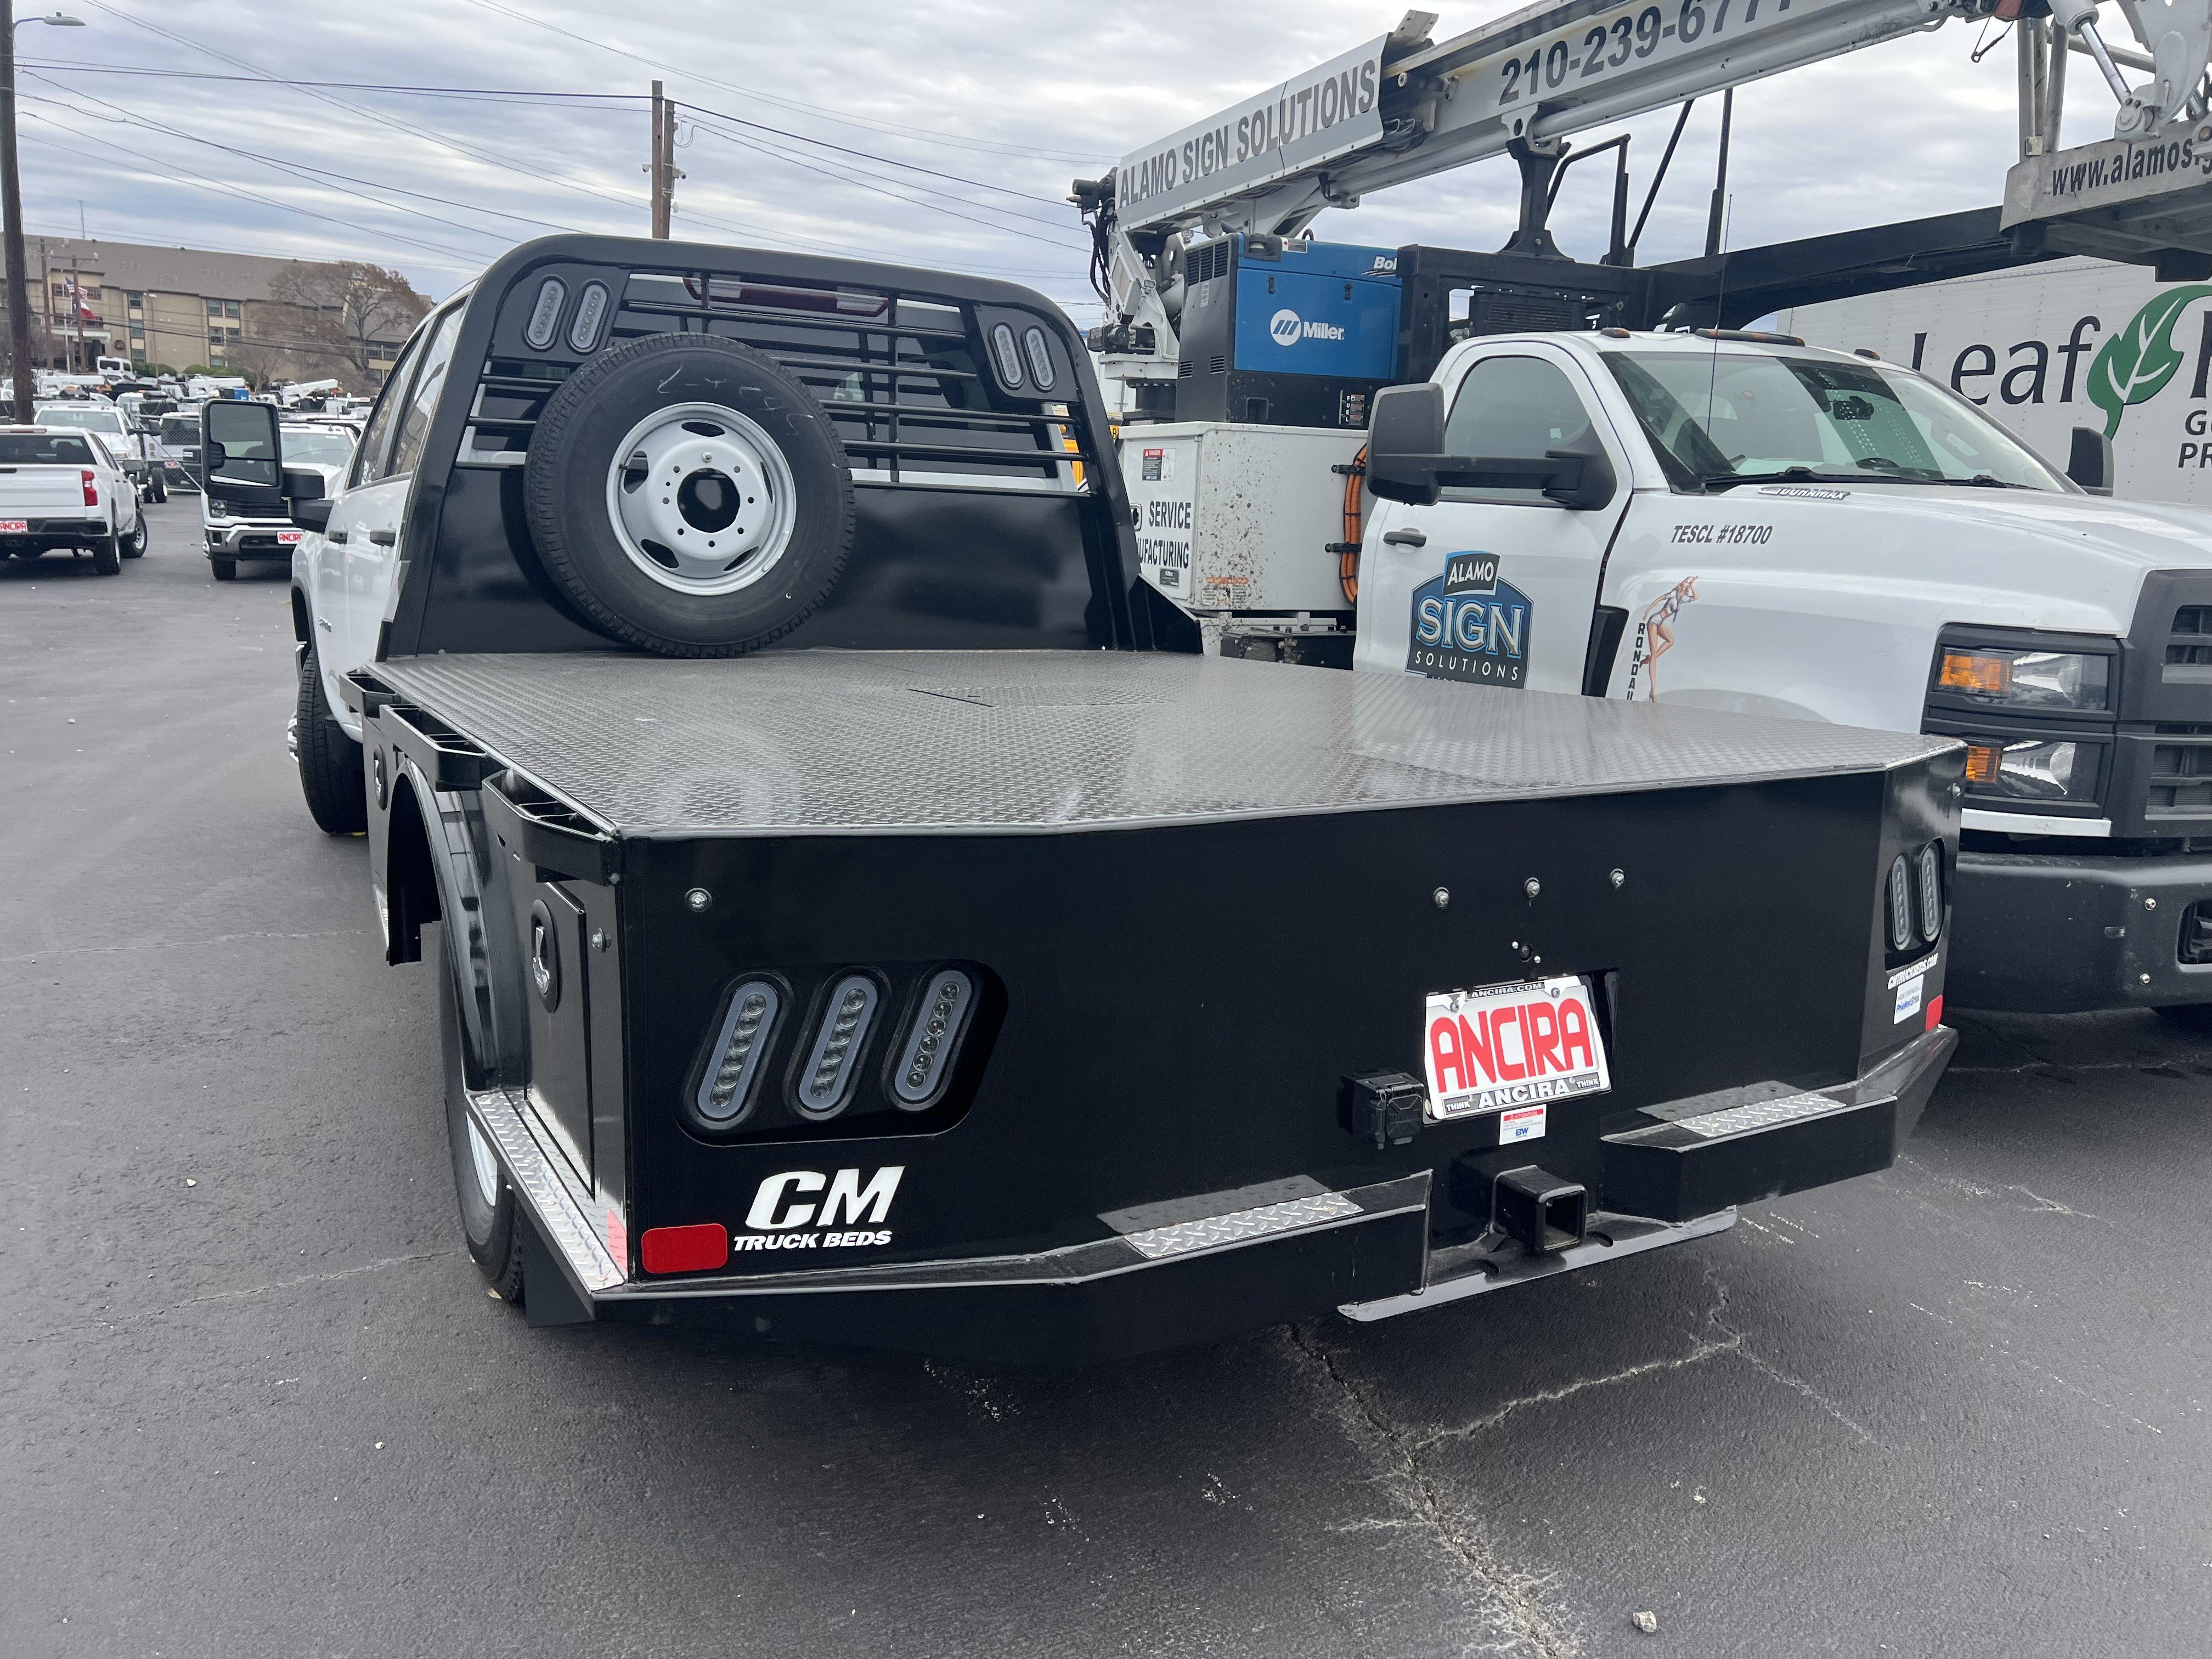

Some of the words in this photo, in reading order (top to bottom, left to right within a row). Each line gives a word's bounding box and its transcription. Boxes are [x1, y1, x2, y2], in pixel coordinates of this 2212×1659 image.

[1499, 0, 1791, 105] 210-239-67
[1119, 148, 1177, 209] ALAMO
[1182, 125, 1229, 184] SIGN
[1237, 59, 1375, 162] SOLUTIONS
[2052, 138, 2212, 196] www.alamos
[1149, 500, 1192, 529] SERVICE
[1671, 524, 1714, 543] TESCL
[1716, 524, 1773, 545] #18700
[1137, 538, 1189, 569] UFACTURING
[1447, 560, 1494, 586] ALAMO
[1417, 596, 1524, 658] SIGN
[1415, 651, 1519, 681] SOLUTIONS
[1471, 983, 1543, 998] ANCIRA.COM
[1430, 998, 1594, 1093] ANCIRA
[1446, 1101, 1471, 1111] THINK
[1478, 1079, 1570, 1108] ANCIRA
[1576, 1077, 1600, 1088] THINK
[745, 1166, 905, 1231] CM
[733, 1232, 821, 1251] TRUCK
[822, 1229, 893, 1248] BEDS
